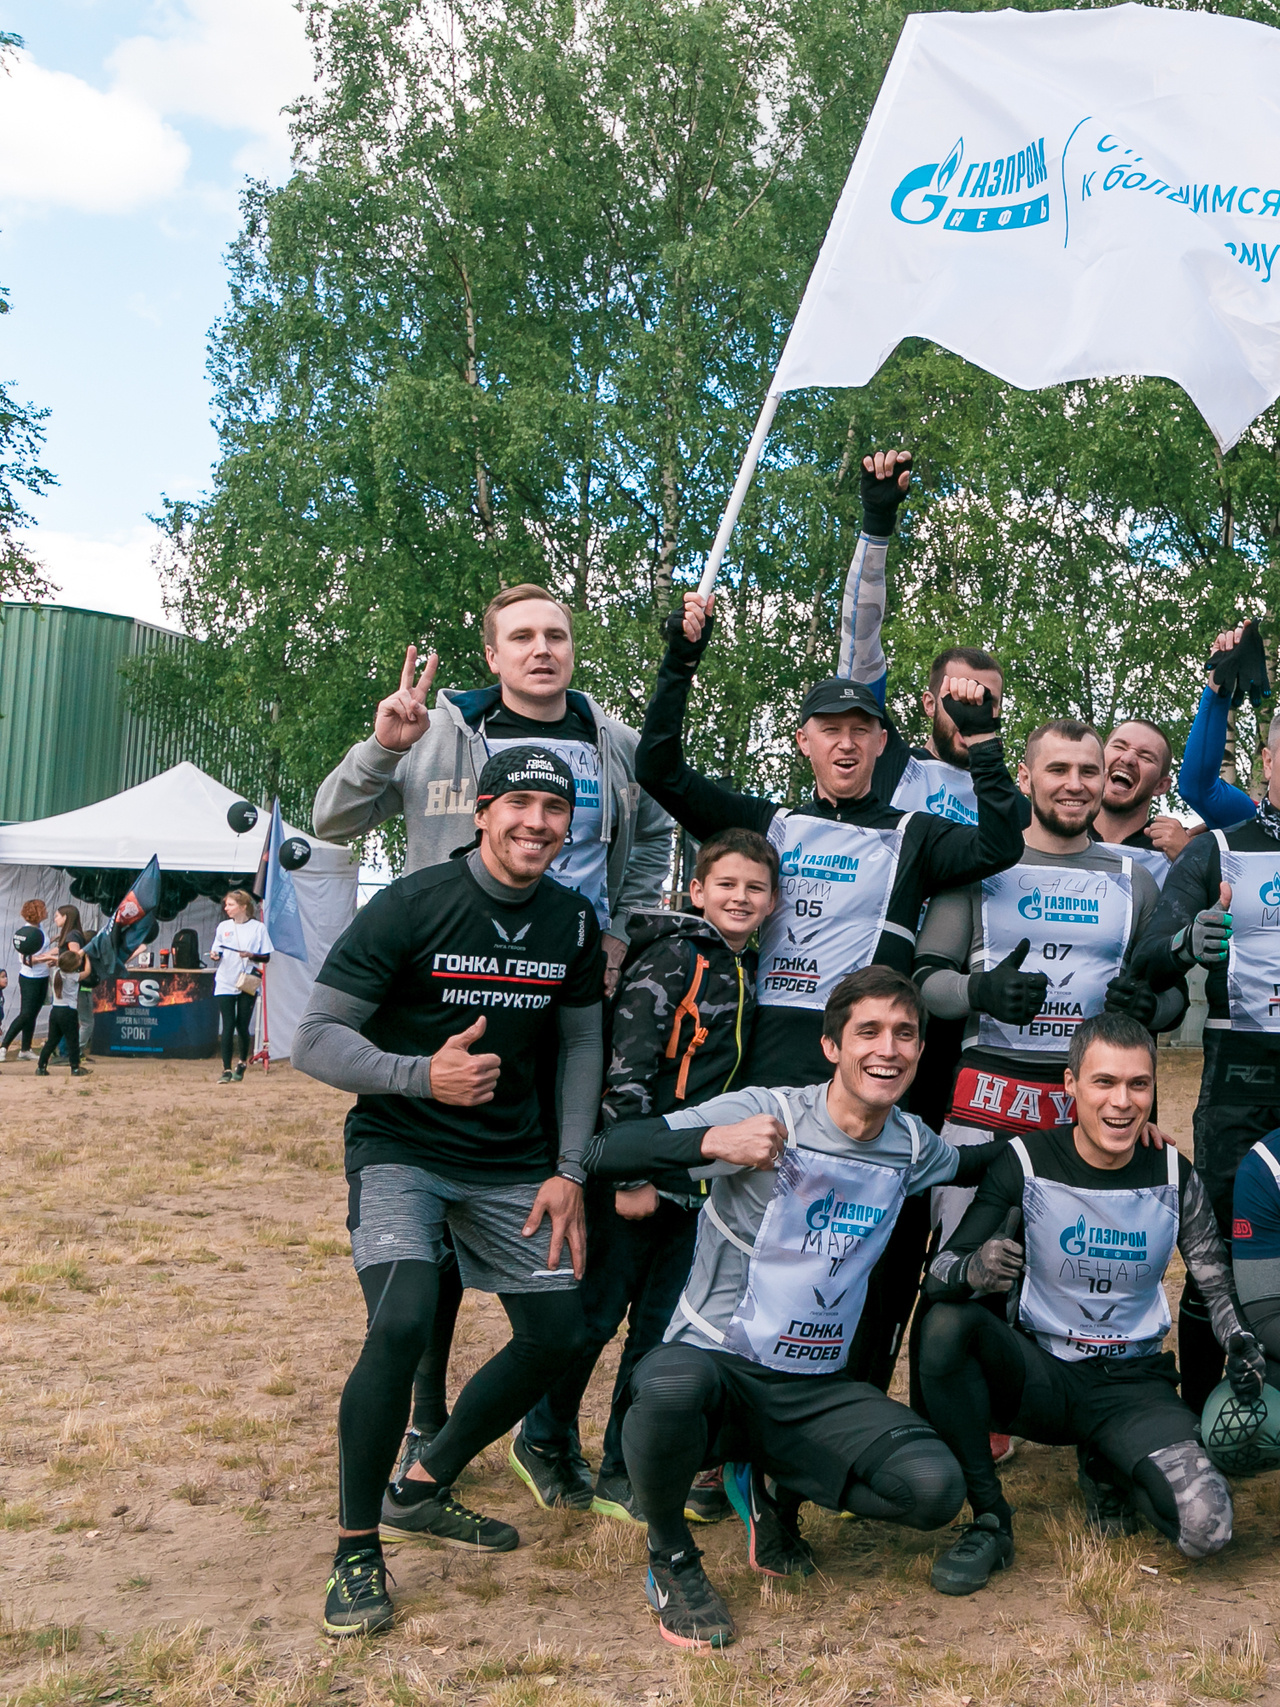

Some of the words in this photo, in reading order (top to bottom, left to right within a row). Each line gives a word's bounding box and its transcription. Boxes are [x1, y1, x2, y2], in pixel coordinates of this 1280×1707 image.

[957, 137, 1048, 197] ГАЗПРОМ
[949, 200, 1047, 229] НЕФТЬ
[507, 770, 569, 790] ЧЕМПИОНАТ
[802, 854, 860, 871] ГАЗПРОМ
[803, 868, 855, 882] НЕФТЬ
[781, 878, 832, 900] ЮРИЙ
[795, 899, 823, 918] 05
[1044, 896, 1099, 912] ГАЗПРОМ
[1047, 914, 1098, 923] НЕФТЬ
[577, 919, 586, 947] Reebok
[1043, 943, 1073, 962] 07
[433, 953, 499, 974] ГОНКА
[505, 958, 567, 979] ГЕРОЕВ
[773, 957, 818, 973] ГОНКА
[765, 977, 818, 994] ГЕРОЕВ
[442, 988, 551, 1009] ИНСТРУКТОР
[1038, 1002, 1083, 1016] ОНКА
[121, 1026, 152, 1040] SPORT
[1019, 1022, 1081, 1037] ГЕРОЕ
[1089, 1227, 1147, 1247] ГАЗПРОМ
[1090, 1248, 1146, 1260] НЕФТЬ
[1059, 1258, 1152, 1282] ЛЕНАР
[1088, 1278, 1112, 1294] 10
[787, 1320, 844, 1338] ГОНКА
[773, 1342, 842, 1361] ГЕРОЕВ
